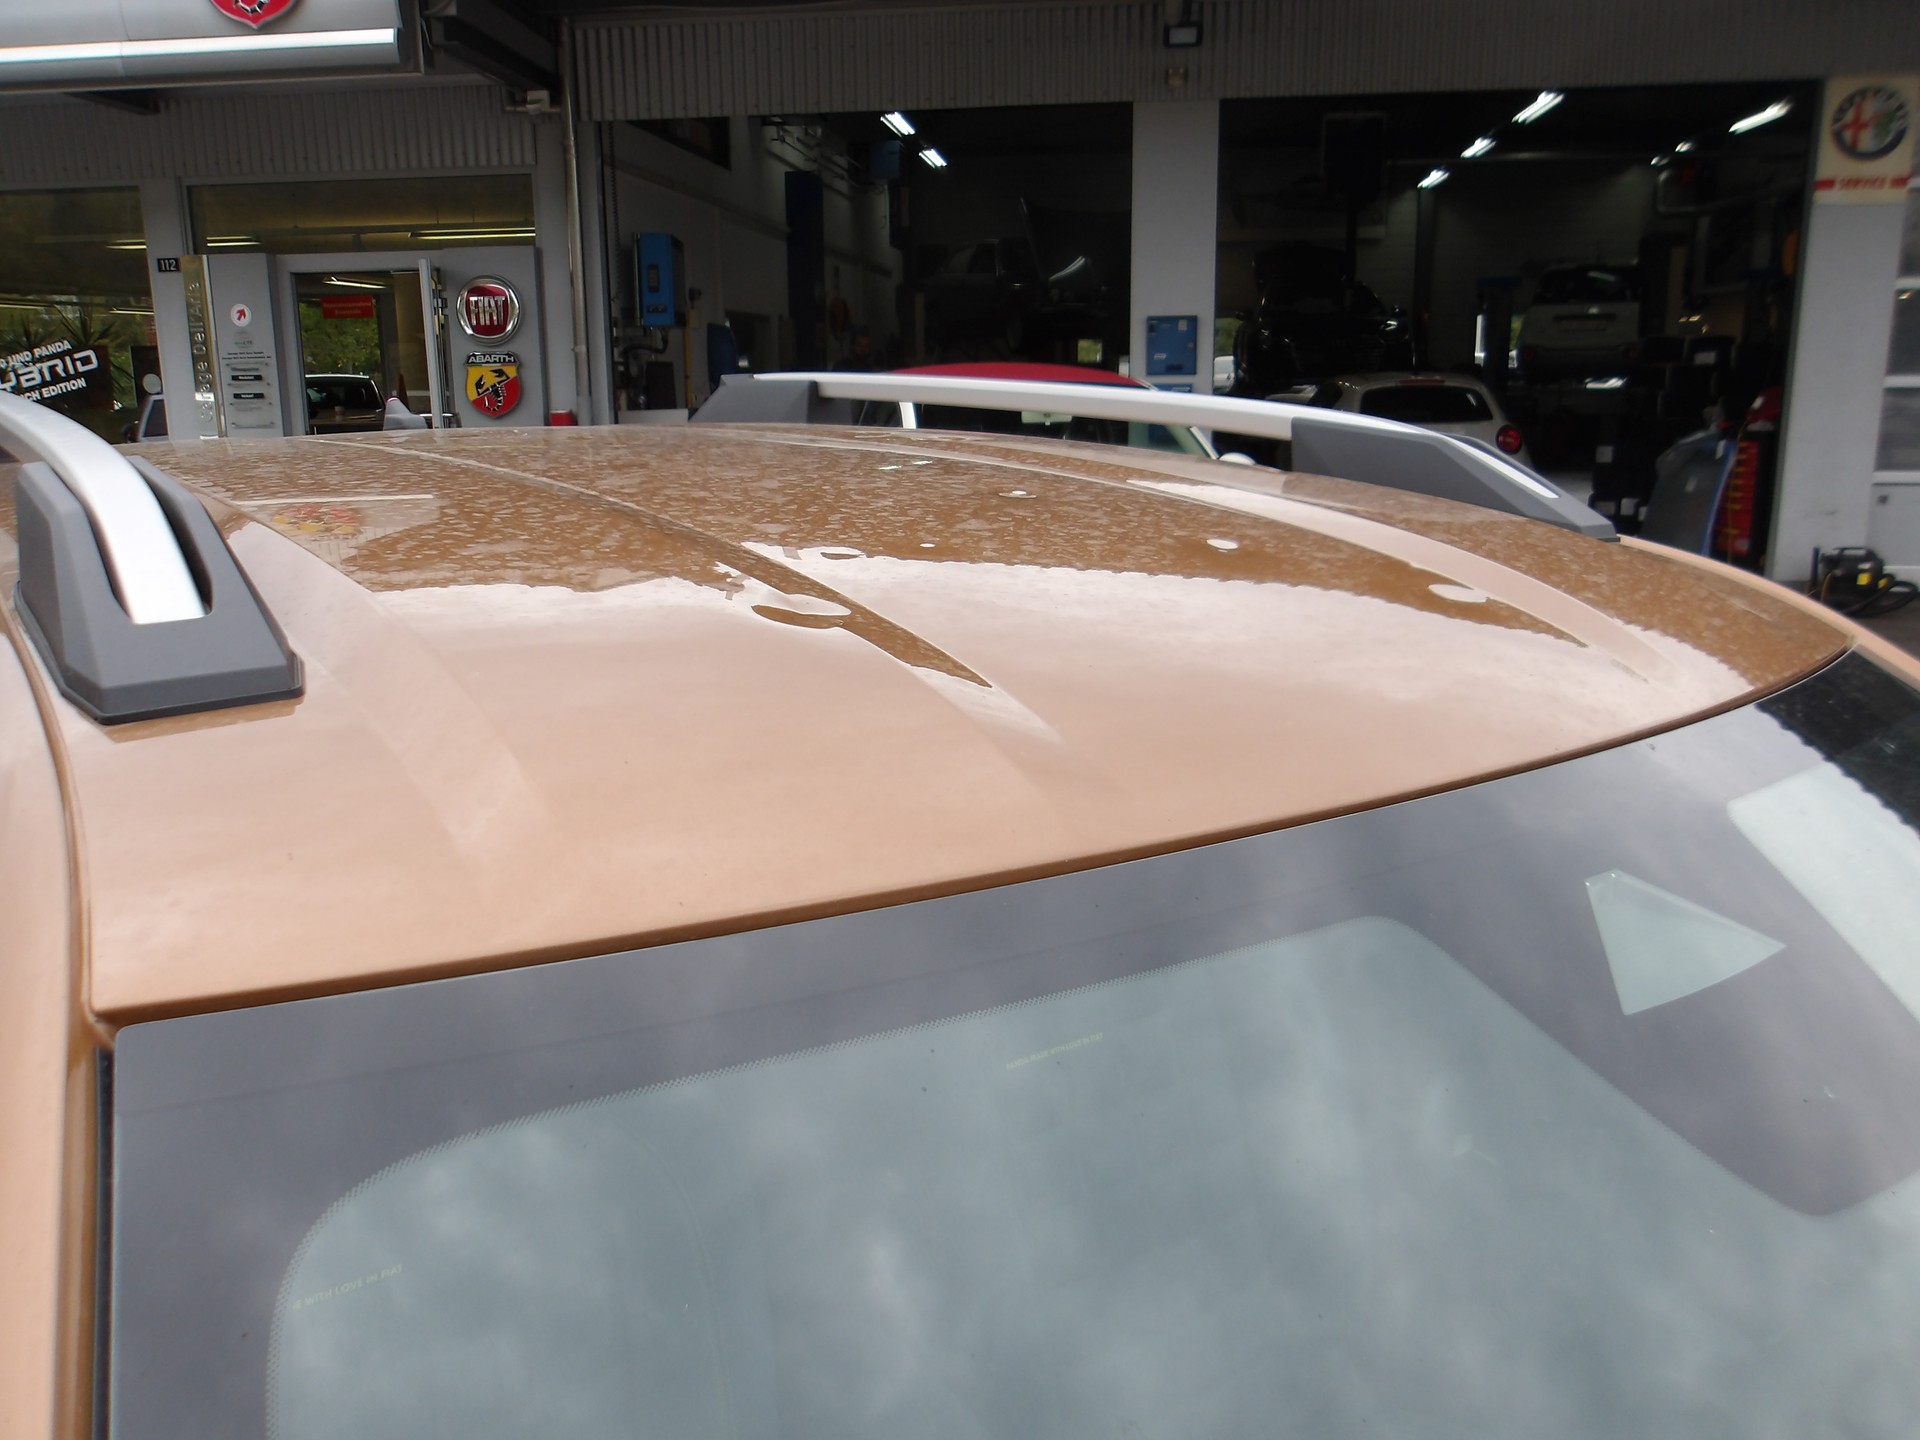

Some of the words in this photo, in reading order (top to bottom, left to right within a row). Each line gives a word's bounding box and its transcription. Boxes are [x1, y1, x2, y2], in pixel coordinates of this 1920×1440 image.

[159, 260, 176, 270] 112
[469, 296, 505, 326] FIAT
[33, 340, 72, 359] PANDA
[468, 354, 514, 363] ABARTH
[41, 377, 87, 399] EDITION
[305, 1289, 332, 1305] WITH
[335, 1278, 363, 1295] LOVE
[366, 1273, 378, 1284] IN
[381, 1263, 402, 1279] FIAT
